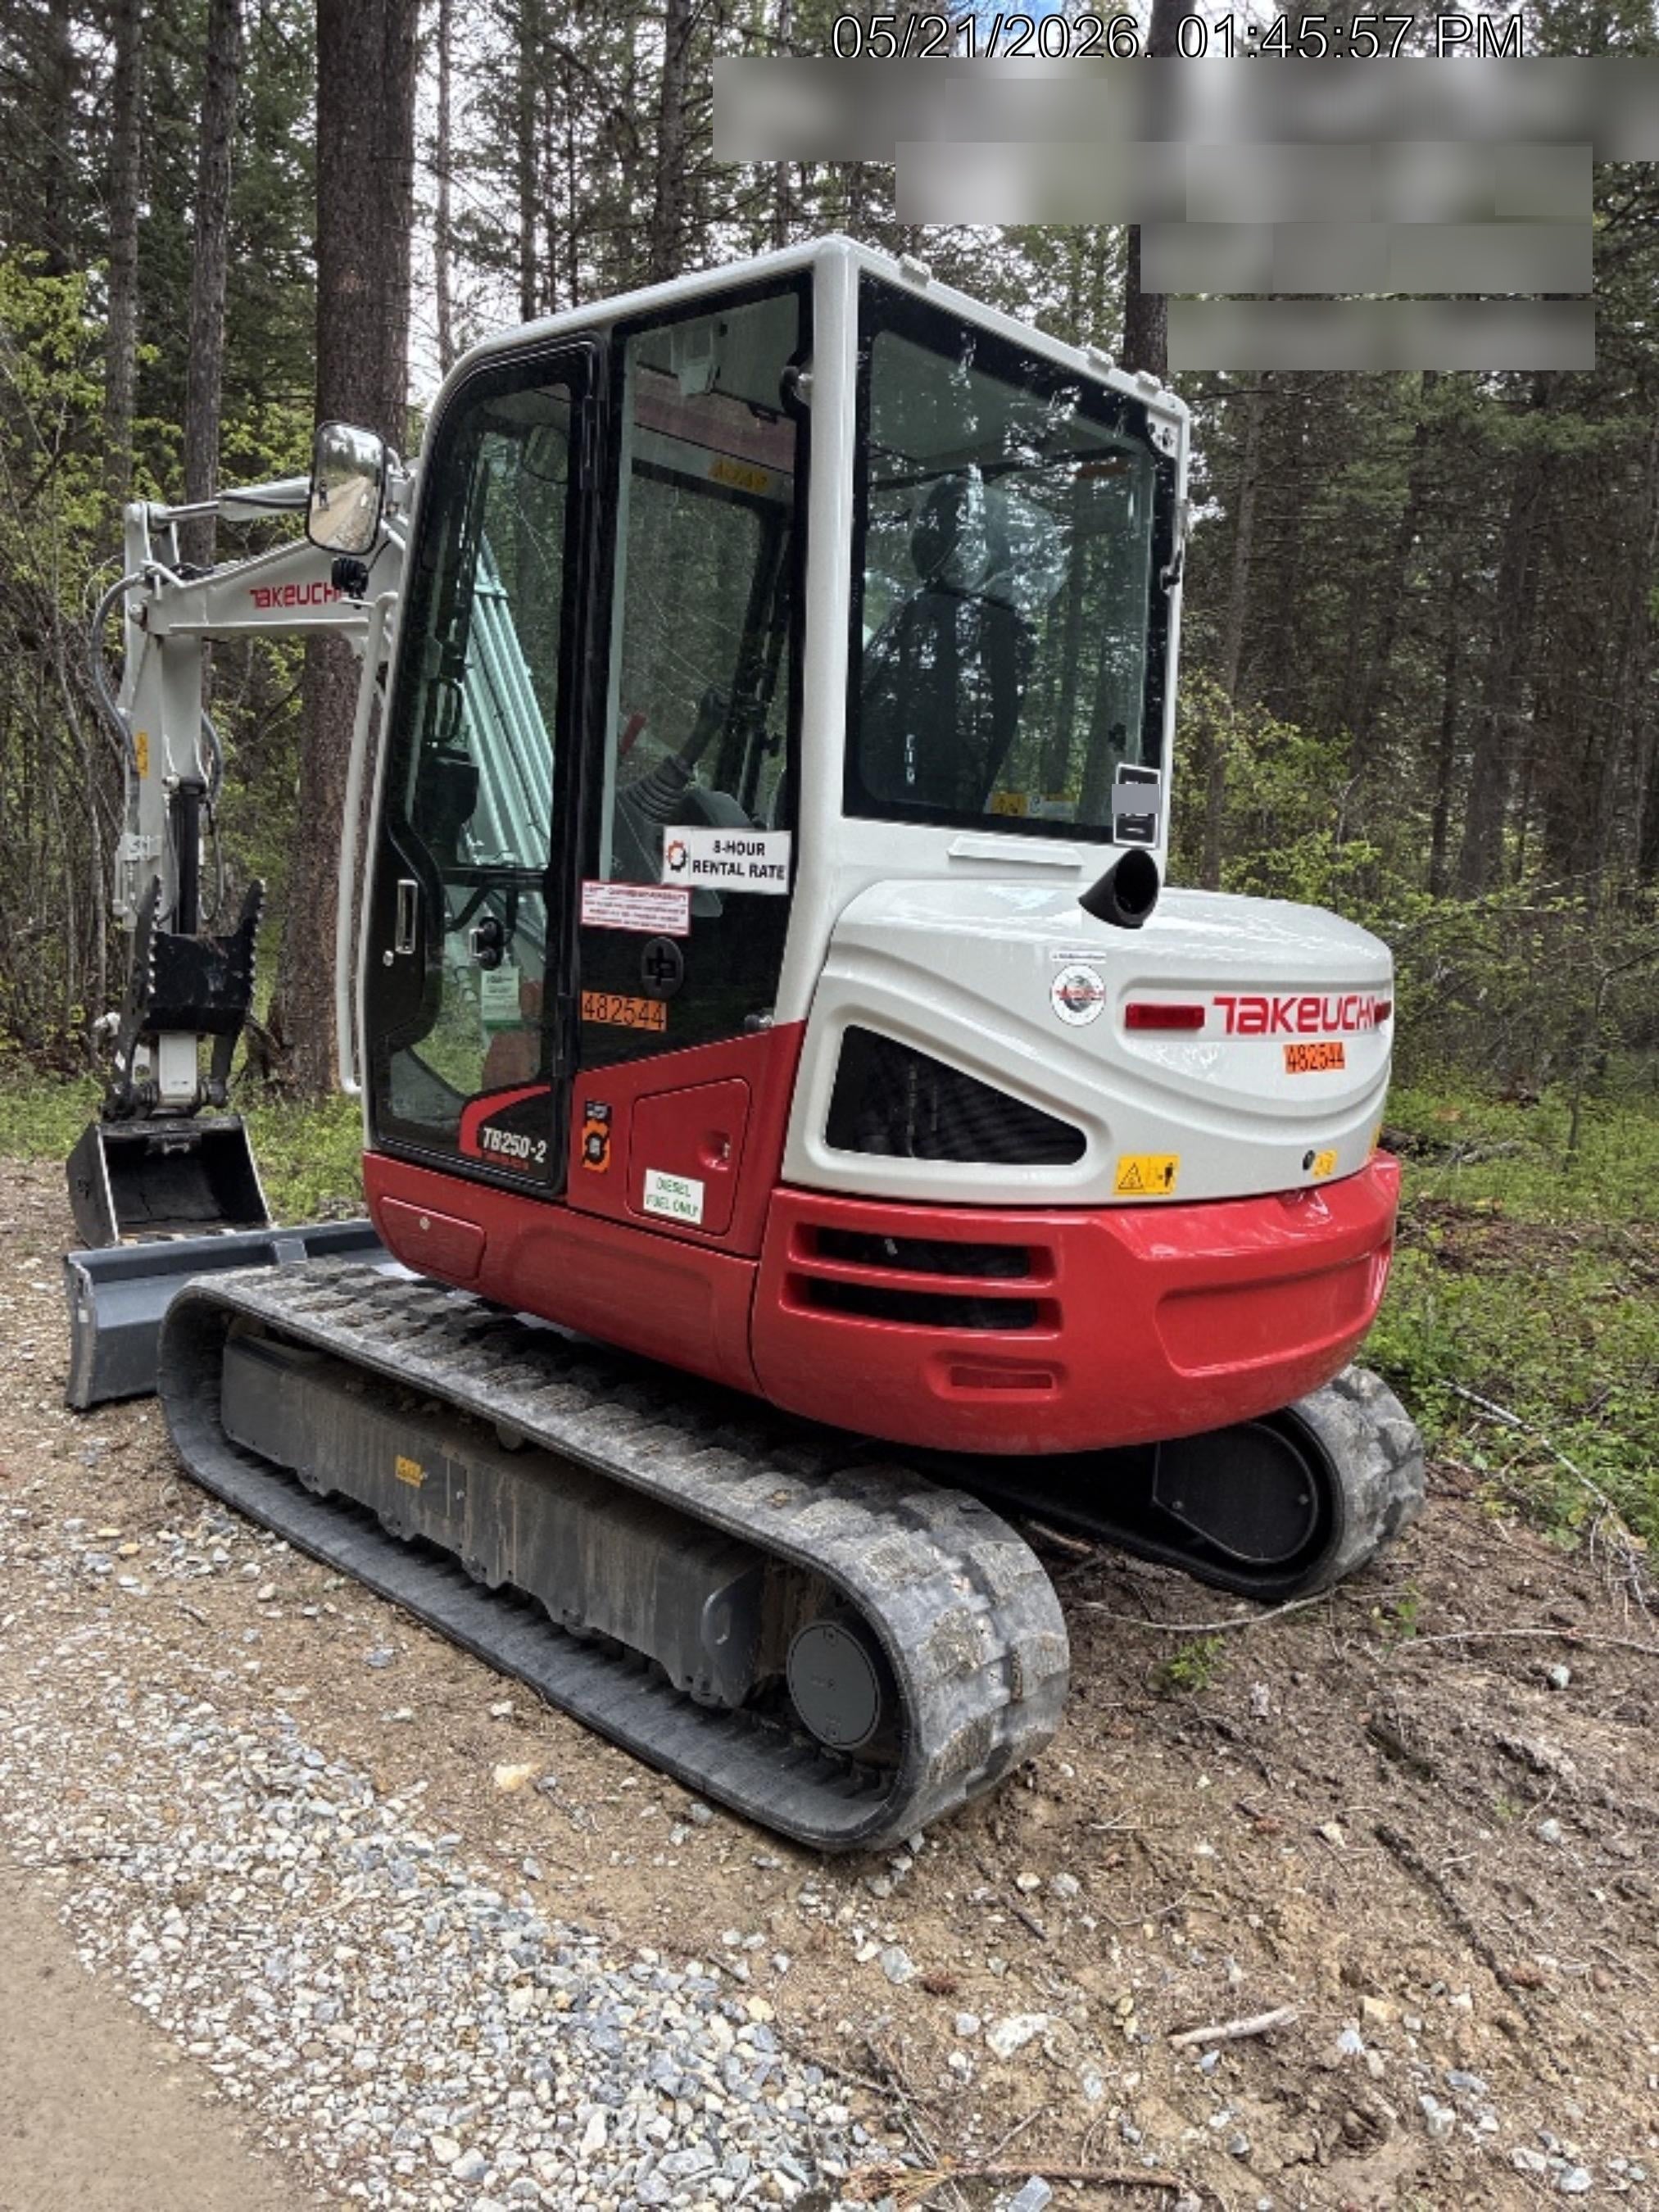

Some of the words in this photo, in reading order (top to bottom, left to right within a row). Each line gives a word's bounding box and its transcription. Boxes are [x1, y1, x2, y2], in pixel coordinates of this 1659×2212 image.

[714, 840, 765, 856] 8-HOUR
[692, 860, 745, 877] RENTAL
[749, 863, 785, 880] RATE
[584, 994, 664, 1030] 482544
[1286, 1043, 1344, 1072] 482544
[483, 1126, 547, 1164] TB250-2
[656, 1176, 691, 1198] DIESEL
[646, 1194, 670, 1210] FUEL
[673, 1199, 699, 1217] ONLY
